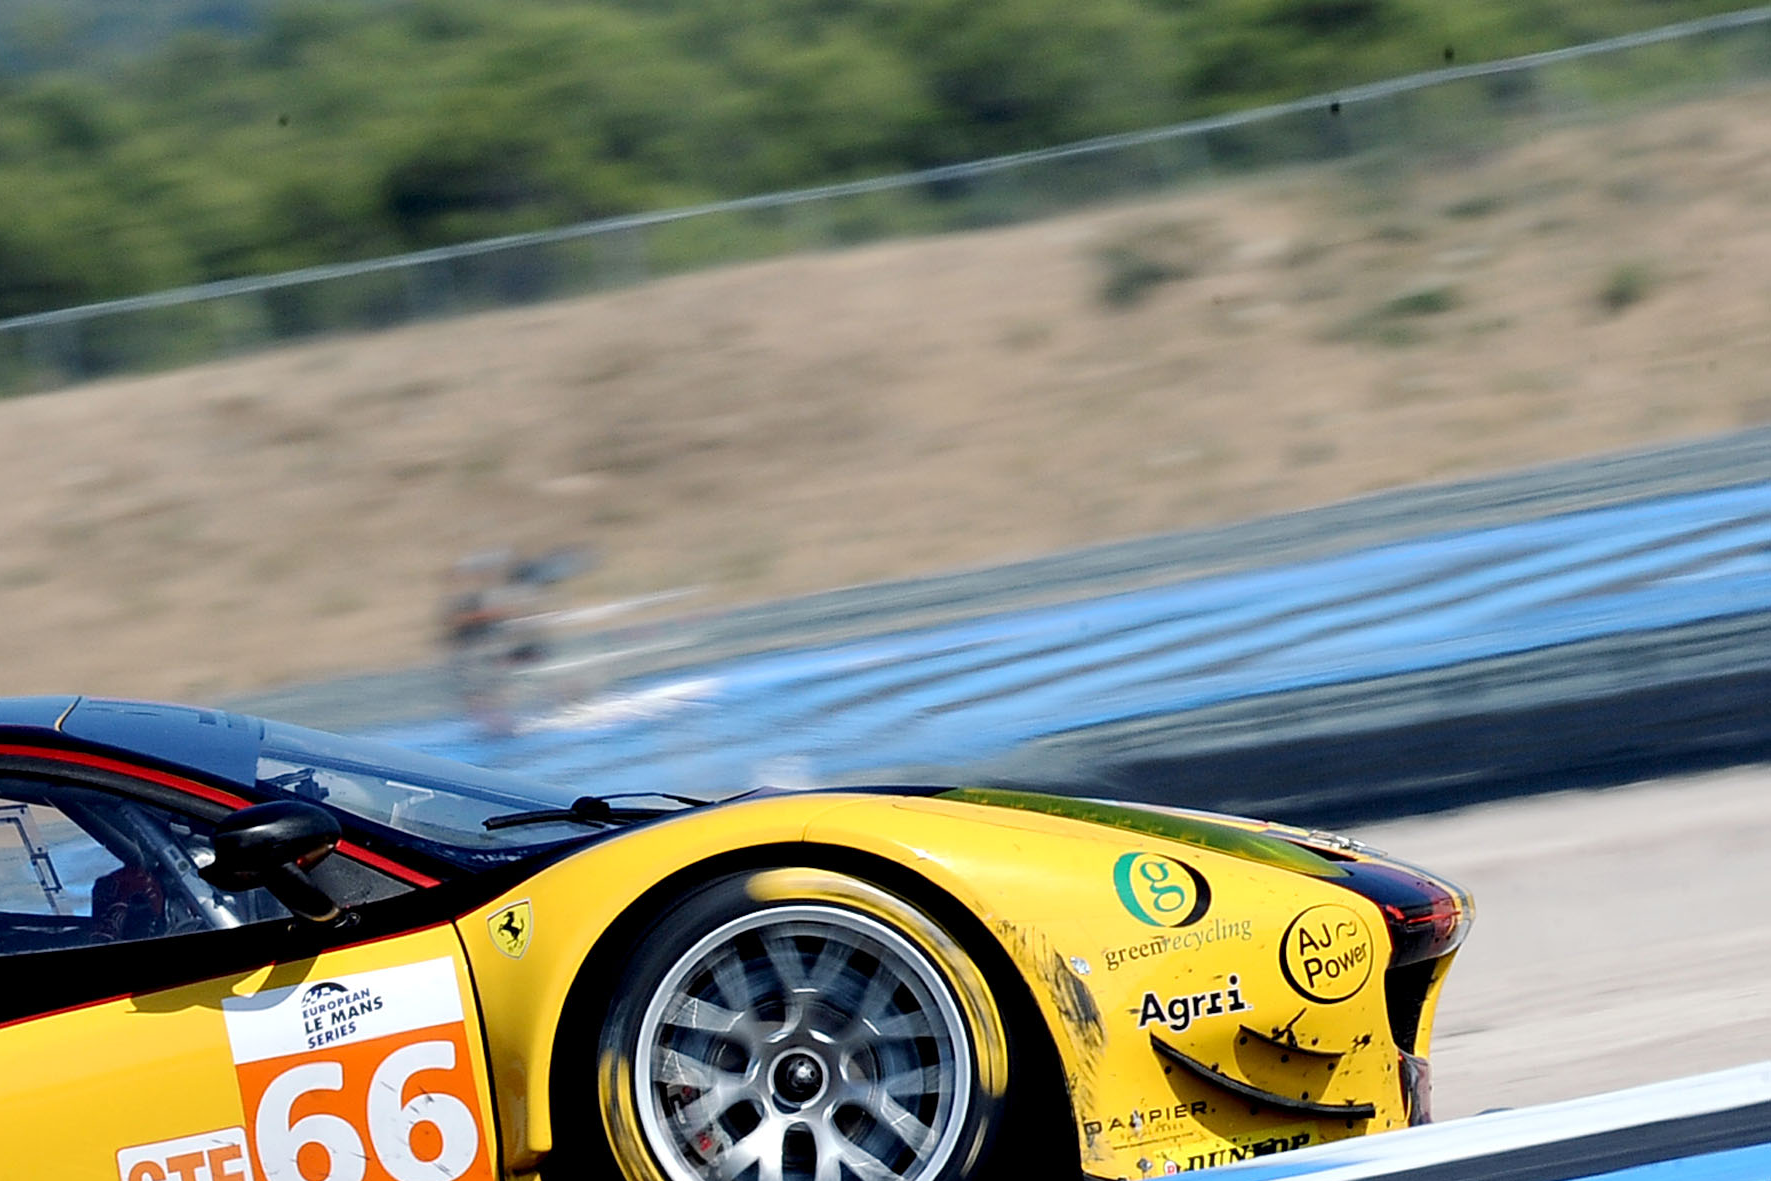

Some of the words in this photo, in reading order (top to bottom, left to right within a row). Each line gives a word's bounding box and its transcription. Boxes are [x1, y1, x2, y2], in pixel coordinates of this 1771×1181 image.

[1299, 924, 1333, 955] AJ
[1303, 942, 1367, 988] Power
[303, 988, 370, 1019] EUROPEAN
[305, 1017, 324, 1034] LE
[331, 996, 383, 1025] MANS
[308, 1021, 357, 1049] SERIES
[1187, 1133, 1310, 1171] DUNOP
